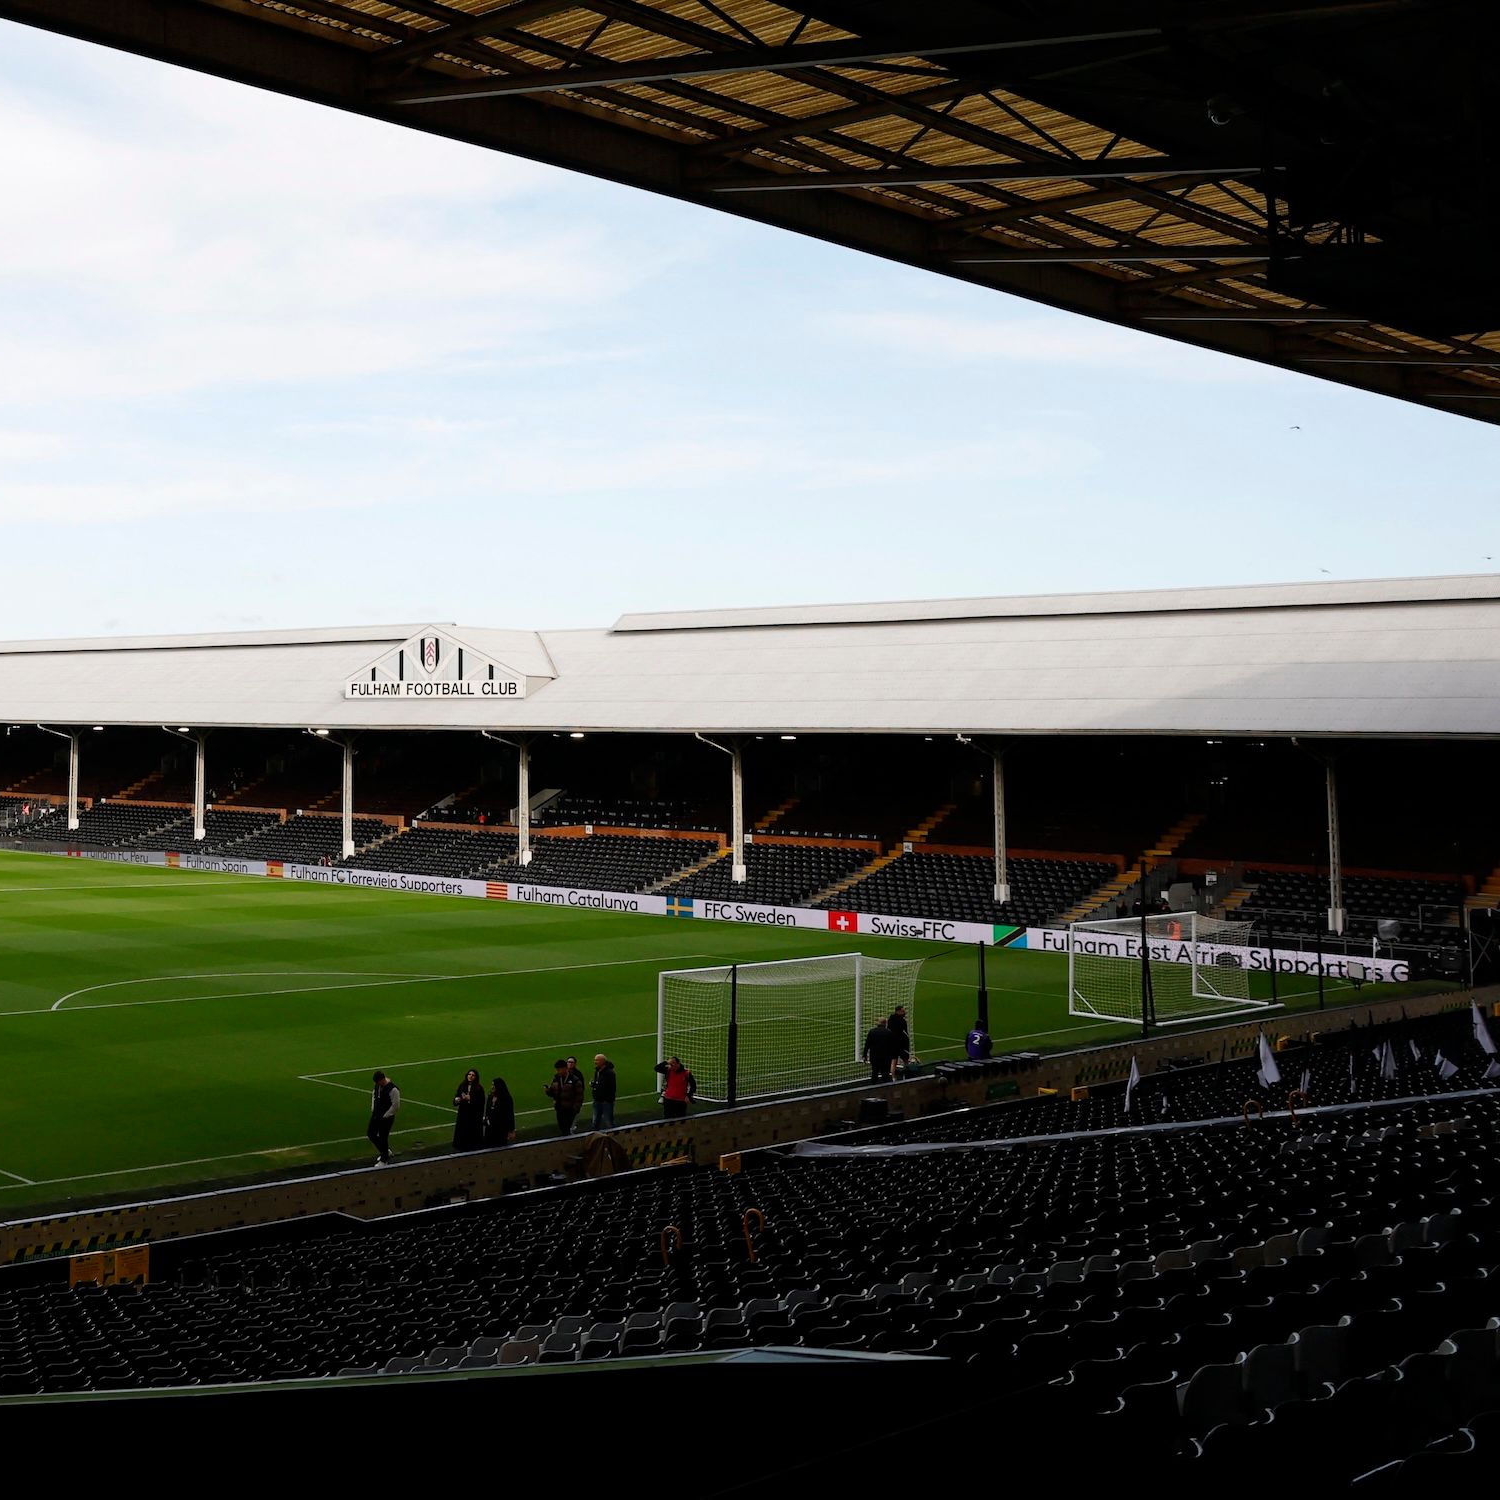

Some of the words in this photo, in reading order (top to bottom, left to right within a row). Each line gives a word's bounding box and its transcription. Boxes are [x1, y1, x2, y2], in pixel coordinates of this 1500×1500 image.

[351, 683, 400, 695] FULHAM
[406, 683, 474, 695] FOOTBALL
[482, 682, 517, 695] CLUB
[131, 850, 149, 864] Peru
[186, 855, 221, 871] Fulham
[222, 858, 248, 874] Spain
[290, 865, 329, 881] Fulham
[331, 869, 344, 883] FC
[347, 871, 398, 889] Torrevieja
[400, 875, 463, 895] Supporters
[517, 886, 565, 905] Fulham
[567, 891, 639, 912] Catalunya
[705, 902, 732, 920] FFC
[735, 905, 796, 926] Sweden
[871, 917, 917, 937] Swiss
[923, 921, 955, 941] FFC
[1043, 931, 1119, 956] Fulham
[1126, 939, 1171, 961] East
[1176, 943, 1242, 968] Afria
[1250, 950, 1384, 982] Supportrs
[973, 1035, 980, 1045] 2
